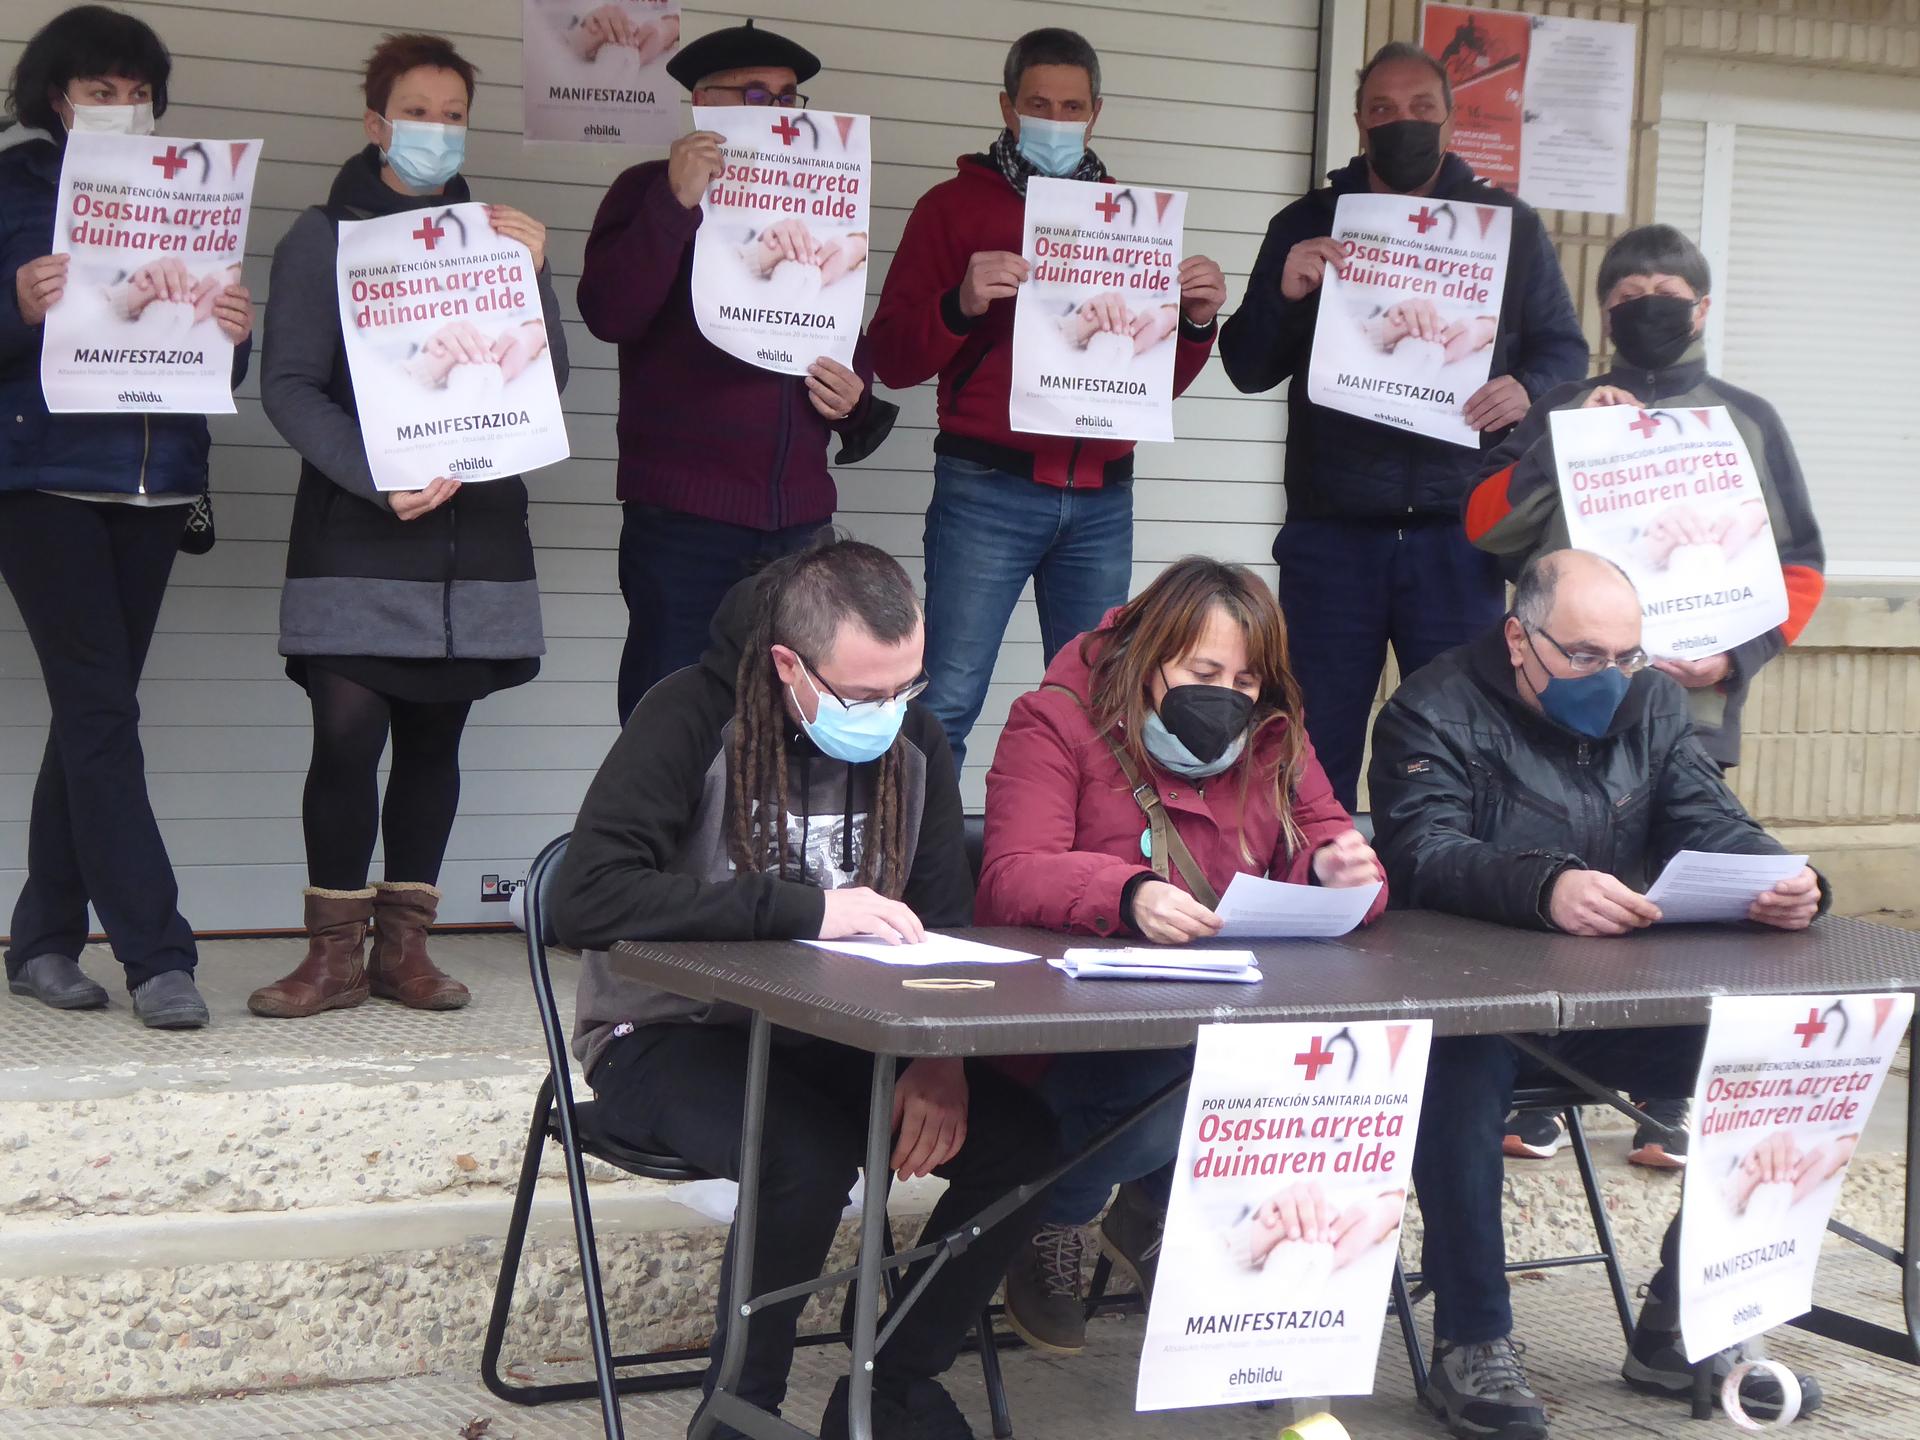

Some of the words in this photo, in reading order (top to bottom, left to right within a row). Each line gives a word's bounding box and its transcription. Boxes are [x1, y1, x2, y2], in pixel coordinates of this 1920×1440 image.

[549, 86, 656, 104] MANIFESTAZIOA
[584, 125, 621, 137] ehbildu
[730, 149, 748, 160] UNA
[750, 150, 790, 164] ATENCIÓN
[792, 156, 834, 169] SANITARIA
[836, 162, 861, 172] DIGNA
[73, 181, 94, 192] POR
[96, 184, 118, 195] UNA
[120, 186, 170, 200] ATENCIÓN
[172, 191, 222, 202] SANITARIA
[222, 192, 245, 202] DIGNA
[793, 171, 859, 194] arreta
[72, 194, 168, 224] Osasun
[174, 205, 242, 227] arreta
[710, 183, 806, 214] duinaren
[812, 196, 856, 219] alde
[71, 221, 187, 252] duinaren
[193, 229, 238, 252] alde
[1035, 226, 1052, 236] POR
[1054, 228, 1070, 236] UNA
[1072, 229, 1110, 240] ATENCIÓN
[1112, 234, 1150, 244] SANITARIA
[1151, 238, 1173, 246] DIGNA
[1342, 231, 1360, 240] POR
[1361, 232, 1379, 242] UNA
[1380, 236, 1422, 250] ATENCIÓN
[1424, 243, 1468, 258] SANITARIA
[1470, 250, 1497, 261] DIGNA
[349, 268, 368, 280] POR
[369, 266, 389, 276] UNA
[390, 259, 438, 274] ATENCIÓN
[439, 255, 490, 269] SANITARIA
[491, 251, 520, 262] DIGNA
[1035, 236, 1108, 261] Osasun
[1113, 246, 1172, 268] arreta
[1343, 240, 1419, 268] Osasun
[1425, 254, 1494, 282] arreta
[352, 278, 440, 303] Osasun
[446, 265, 523, 291] arreta
[1035, 261, 1125, 287] duinaren
[1130, 270, 1170, 292] alde
[1338, 260, 1436, 294] duinaren
[1442, 278, 1488, 304] alde
[357, 297, 469, 330] duinaren
[476, 288, 526, 313] alde
[719, 305, 836, 330] MANIFESTAZIOA
[74, 348, 204, 365] MANIFESTAZIOA
[756, 348, 793, 364] ehbildu
[118, 390, 163, 404] ehbildu
[1040, 375, 1147, 396] MANIFESTAZIOA
[1338, 372, 1456, 406] MANIFESTAZIOA
[397, 410, 530, 442] MANIFESTAZIOA
[1076, 414, 1113, 428] ehbildu
[448, 456, 494, 473] ehbildu
[1573, 462, 1659, 492] Osasun
[1664, 450, 1738, 476] arreta
[1580, 480, 1688, 516] duinaren
[1694, 470, 1744, 496] alde
[1640, 586, 1754, 618] ANIFESTAZIOA
[1712, 1063, 1730, 1075] POR
[1732, 1062, 1754, 1074] UNA
[1756, 1058, 1802, 1072] ATENCIÓN
[1803, 1058, 1852, 1070] SANITARIA
[1853, 1056, 1882, 1068] DIGNA
[1202, 1098, 1226, 1110] POR
[1228, 1098, 1252, 1110] UNA
[1254, 1092, 1310, 1108] ATENCIÓN
[1311, 1094, 1372, 1106] SANITARIA
[1374, 1093, 1408, 1105] DIGNA
[1706, 1075, 1791, 1103] Osasun
[1795, 1070, 1874, 1097] arreta
[1199, 1114, 1304, 1144] Osasun
[1311, 1110, 1404, 1140] arreta
[1702, 1102, 1800, 1136] duinaren
[1806, 1096, 1860, 1124] alde
[1194, 1146, 1326, 1178] duinaren
[1334, 1142, 1396, 1173] alde
[1704, 1238, 1796, 1286] MANIFESTAZIOA
[1185, 1310, 1345, 1336] MANIFESTAZIOA
[1228, 1366, 1282, 1386] ehbildu
